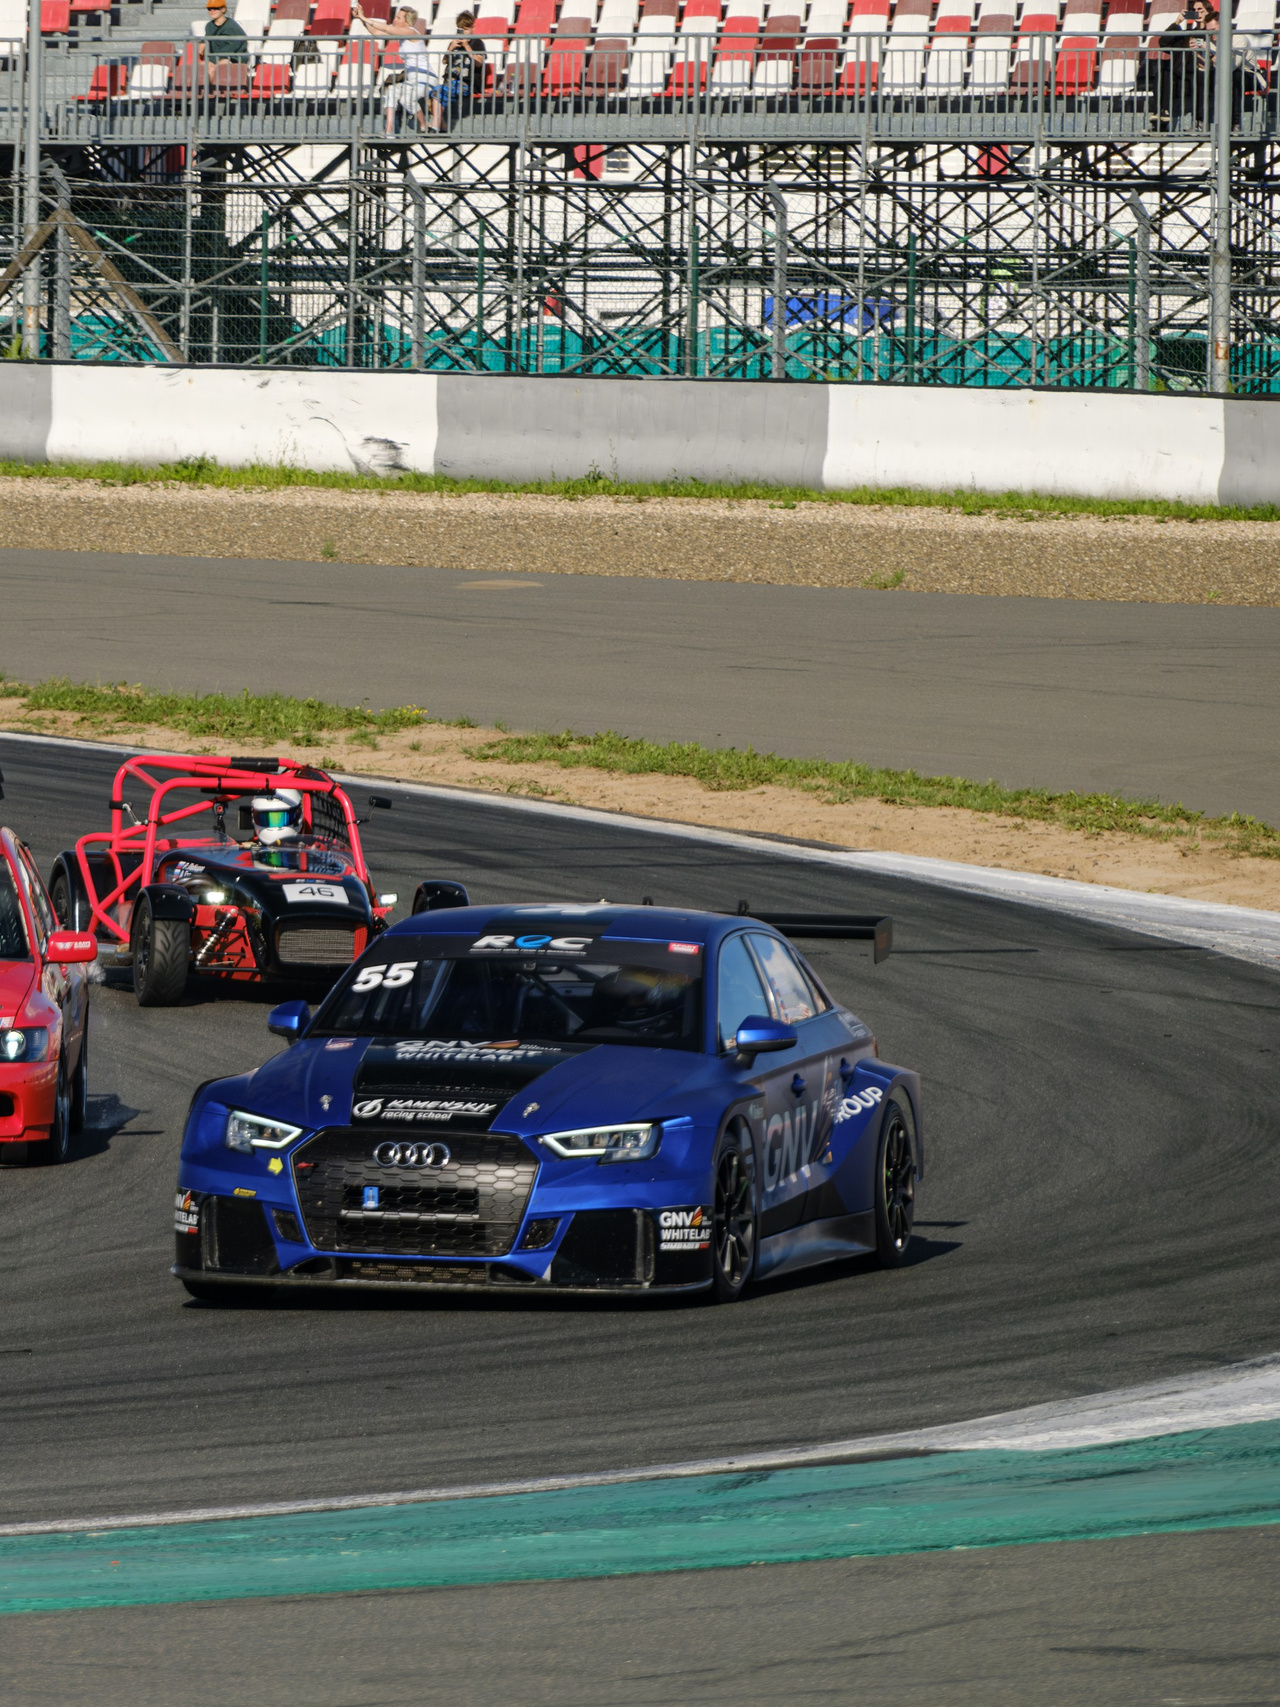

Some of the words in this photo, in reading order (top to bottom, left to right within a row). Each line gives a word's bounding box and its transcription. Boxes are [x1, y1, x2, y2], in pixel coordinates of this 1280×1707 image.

[299, 886, 334, 897] 46
[352, 961, 418, 993] 55
[396, 1040, 493, 1048] GNV
[387, 1099, 497, 1113] KAMENSKIY
[381, 1111, 415, 1121] racing
[417, 1112, 452, 1121] school
[763, 1100, 818, 1192] GNV
[660, 1211, 694, 1228] GNV
[661, 1229, 710, 1240] WHITELAB
